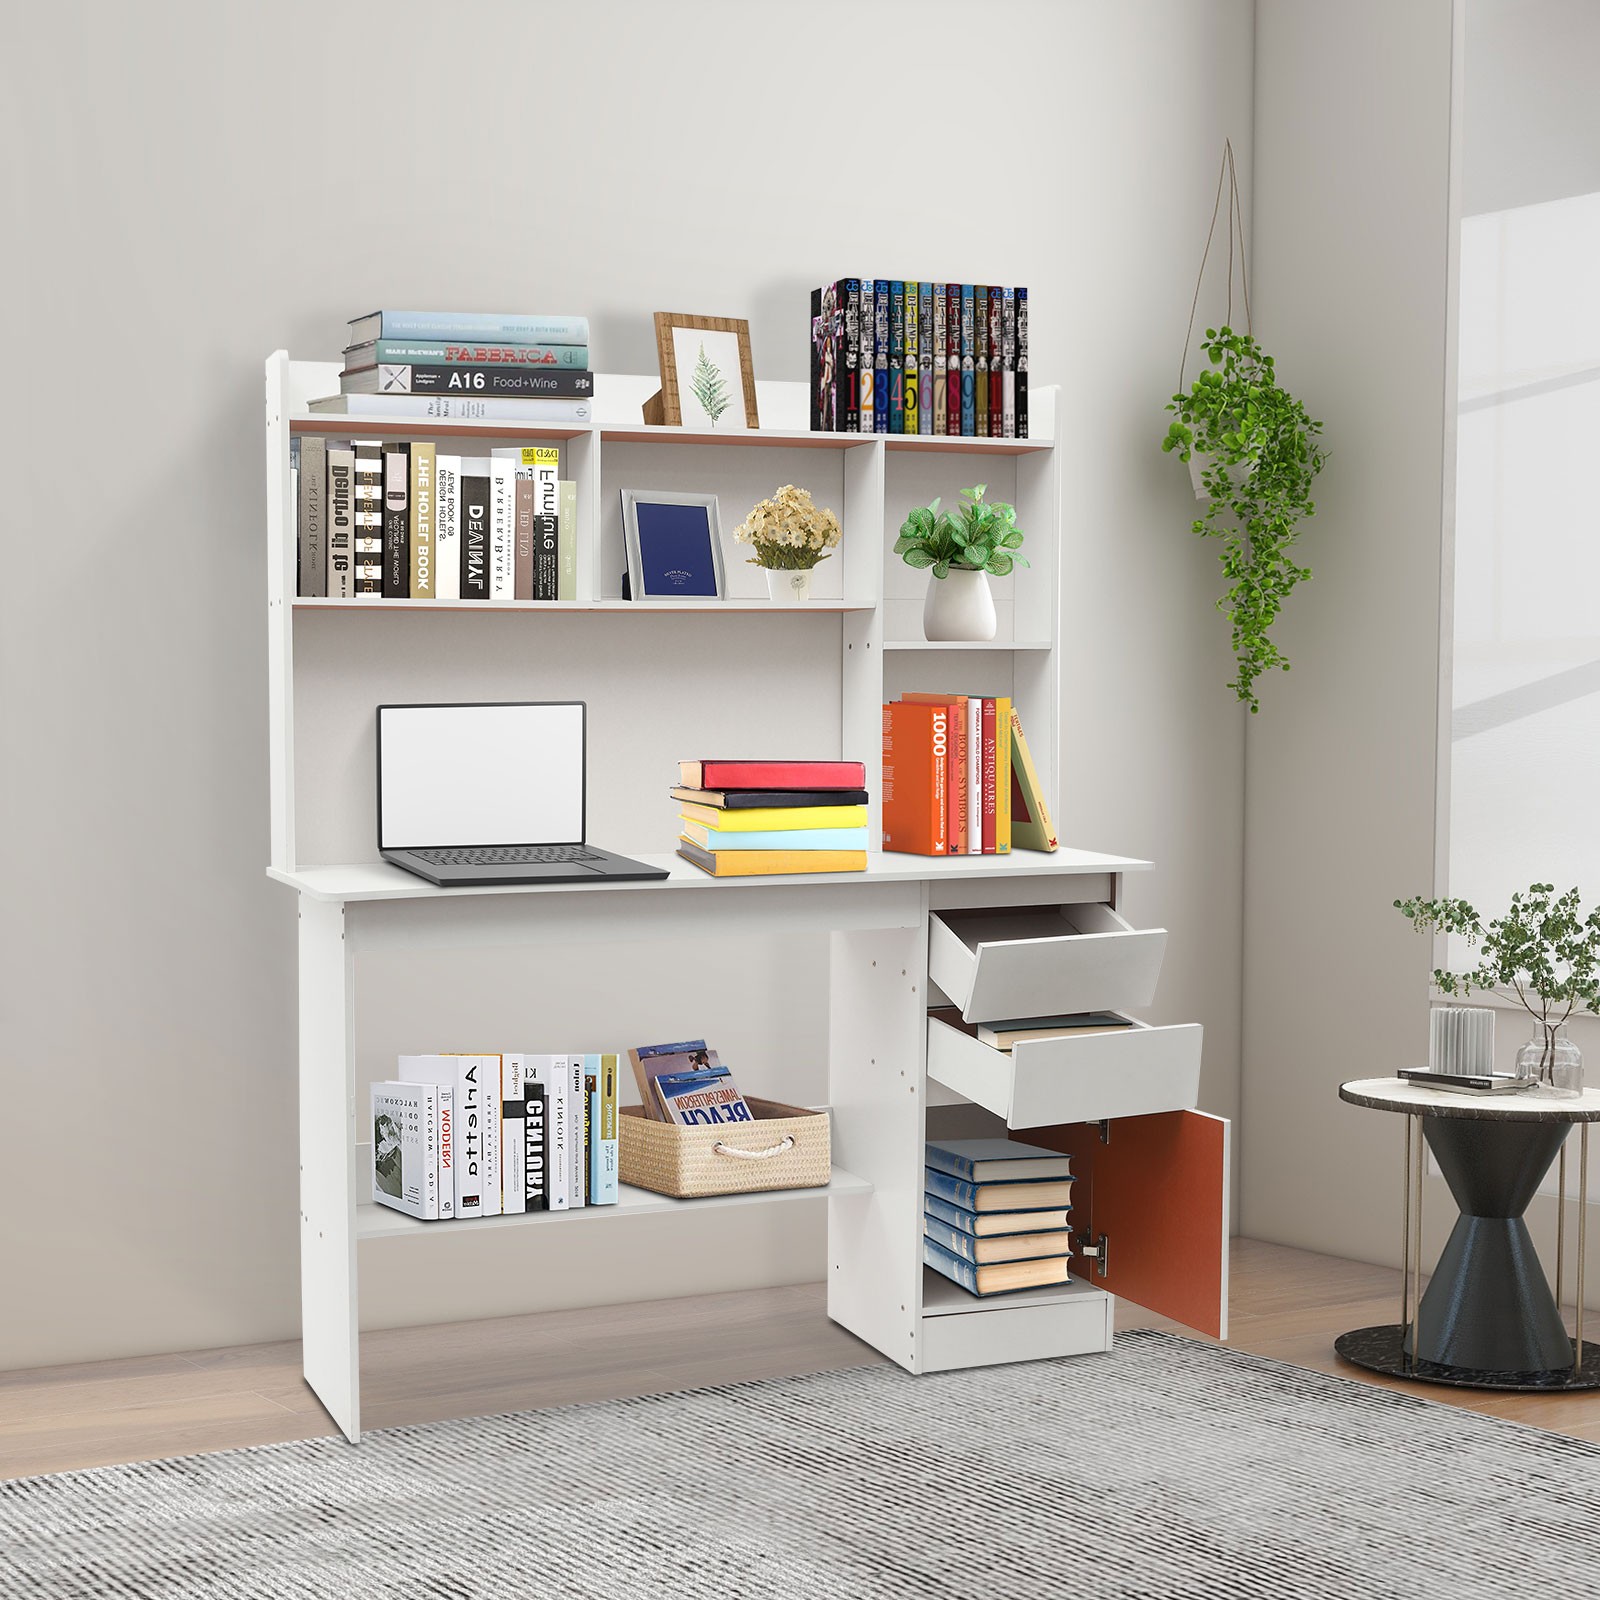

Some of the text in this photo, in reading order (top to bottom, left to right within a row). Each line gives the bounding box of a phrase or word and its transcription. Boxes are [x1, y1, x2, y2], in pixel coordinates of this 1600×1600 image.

[446, 346, 558, 365] FABBRICA
[448, 372, 486, 390] A16
[493, 376, 558, 390] Food+Wine
[848, 374, 857, 410] 1
[861, 372, 874, 410] 2
[876, 373, 888, 410] 3
[890, 373, 903, 410] 4
[905, 374, 916, 410] 5
[920, 374, 932, 410] 6
[935, 374, 946, 410] 7
[949, 374, 960, 410] 8
[962, 374, 974, 410] 9
[933, 712, 946, 756] 1000
[958, 734, 966, 765] BOOK
[986, 738, 995, 815] ANTIQUAIRES
[958, 777, 966, 833] SYMBOLS
